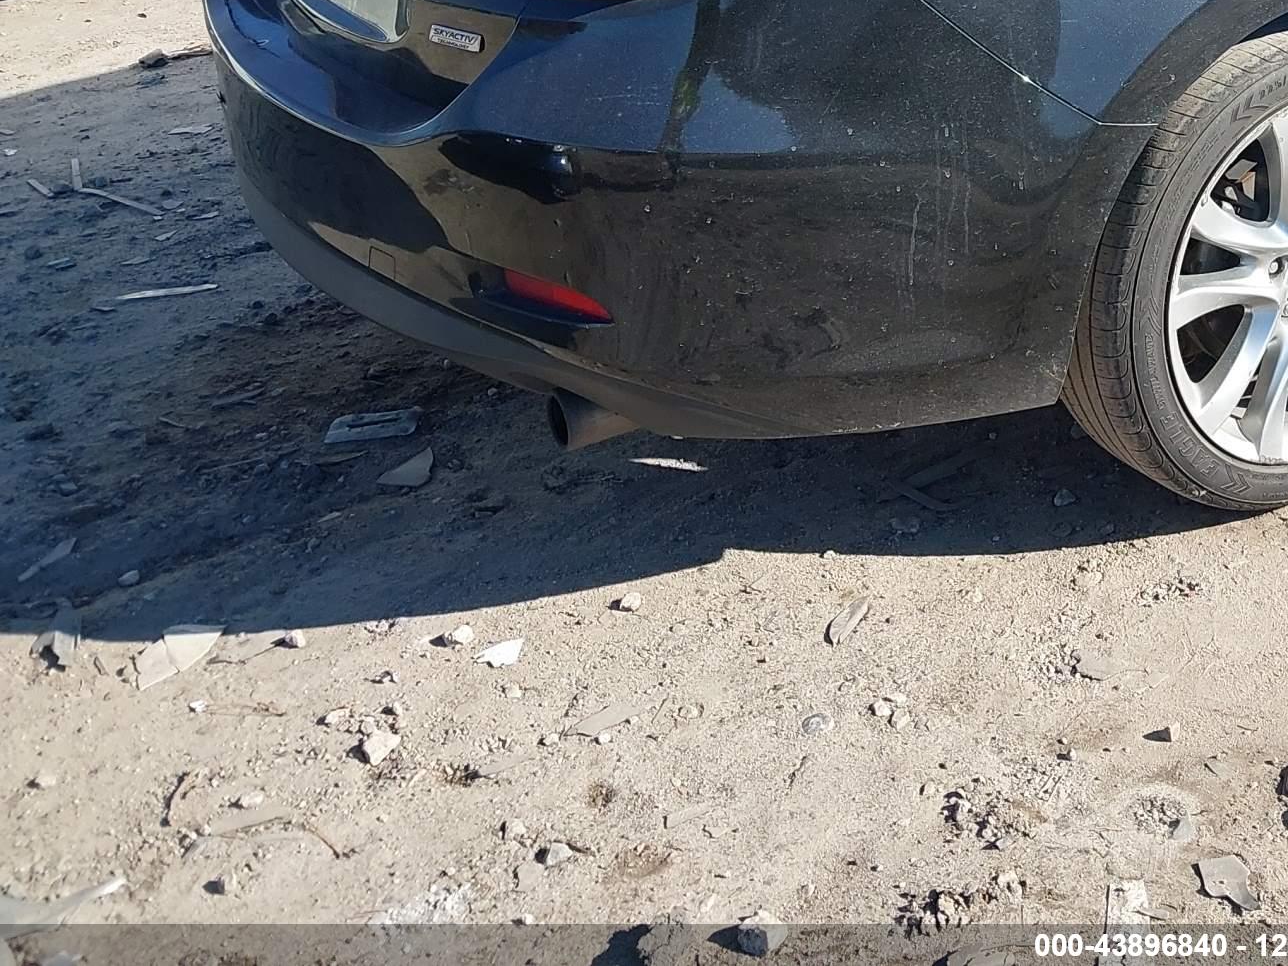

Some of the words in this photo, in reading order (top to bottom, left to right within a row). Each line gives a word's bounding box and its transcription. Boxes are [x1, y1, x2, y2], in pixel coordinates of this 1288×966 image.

[433, 28, 473, 43] SKYACTIV
[437, 38, 470, 49] TECHNOLOGY
[1159, 410, 1221, 478] EAGLE
